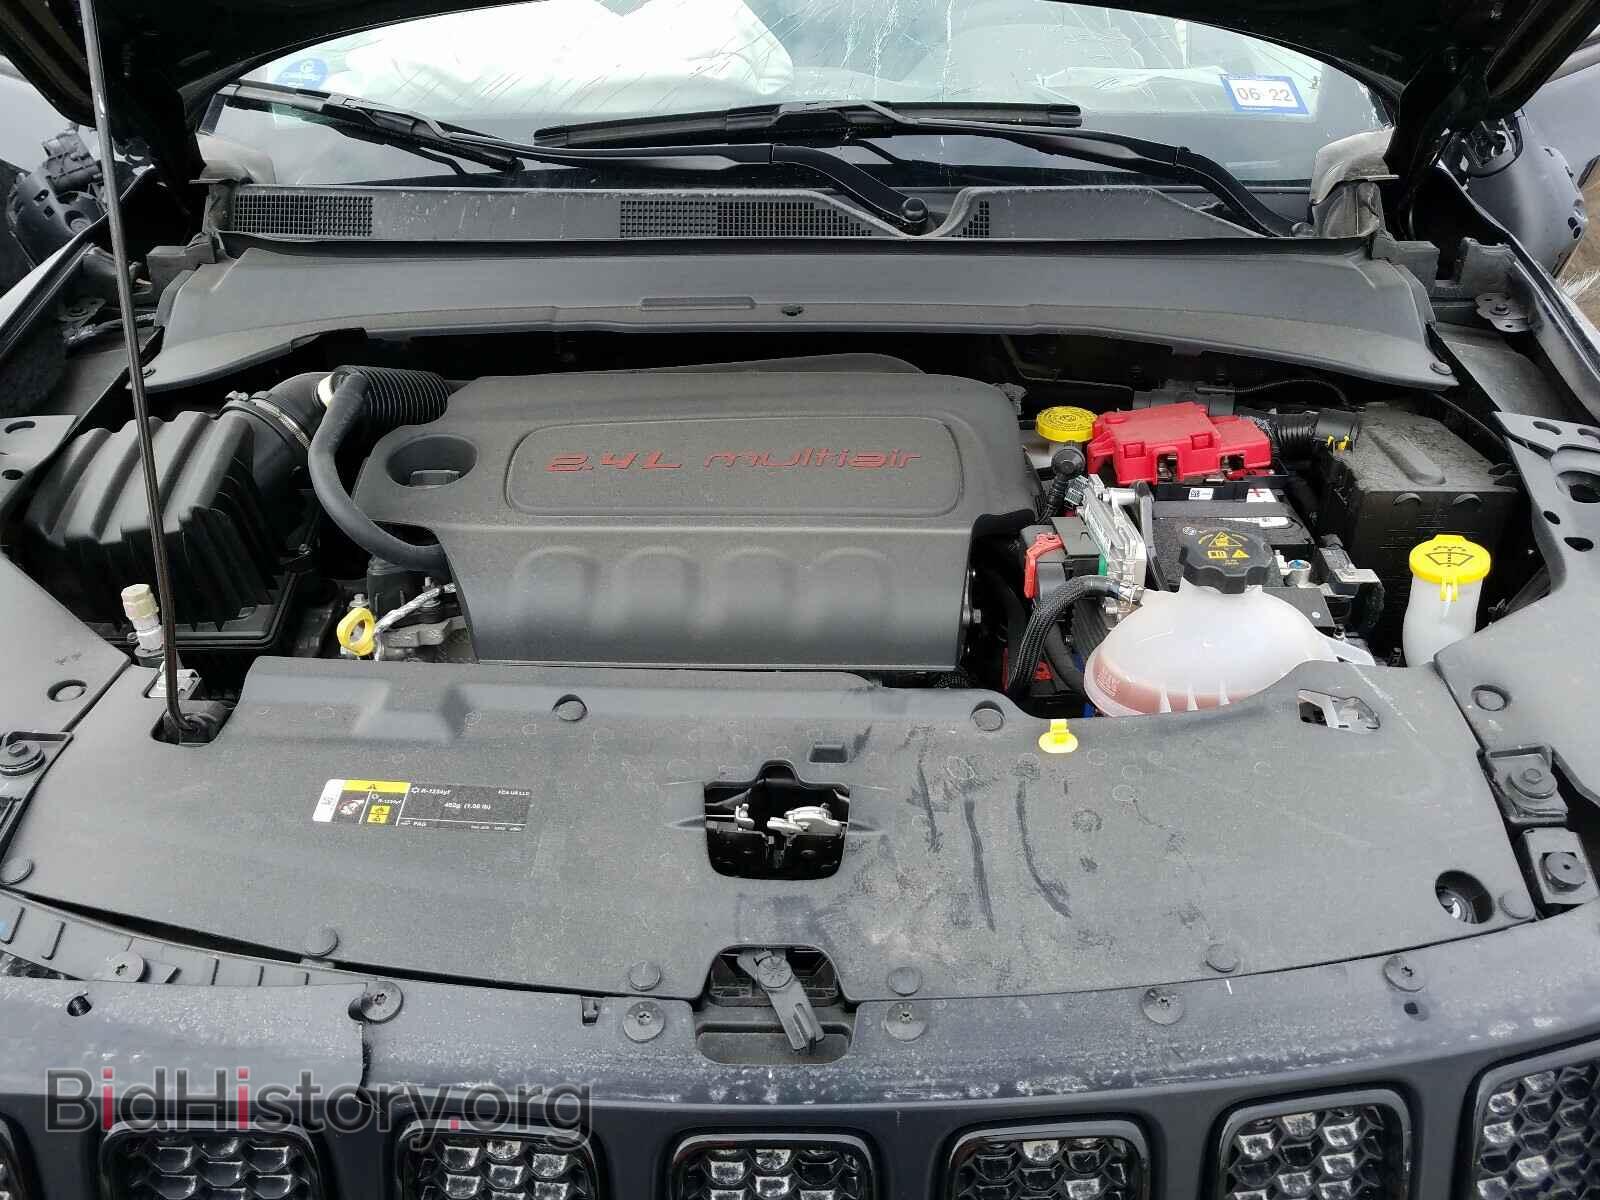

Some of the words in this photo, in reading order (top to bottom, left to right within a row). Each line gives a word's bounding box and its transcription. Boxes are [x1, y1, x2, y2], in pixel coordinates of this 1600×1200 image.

[1236, 87, 1261, 101] 06
[1268, 88, 1294, 102] 22
[545, 450, 683, 472] 2.4L
[703, 448, 921, 469] multiair
